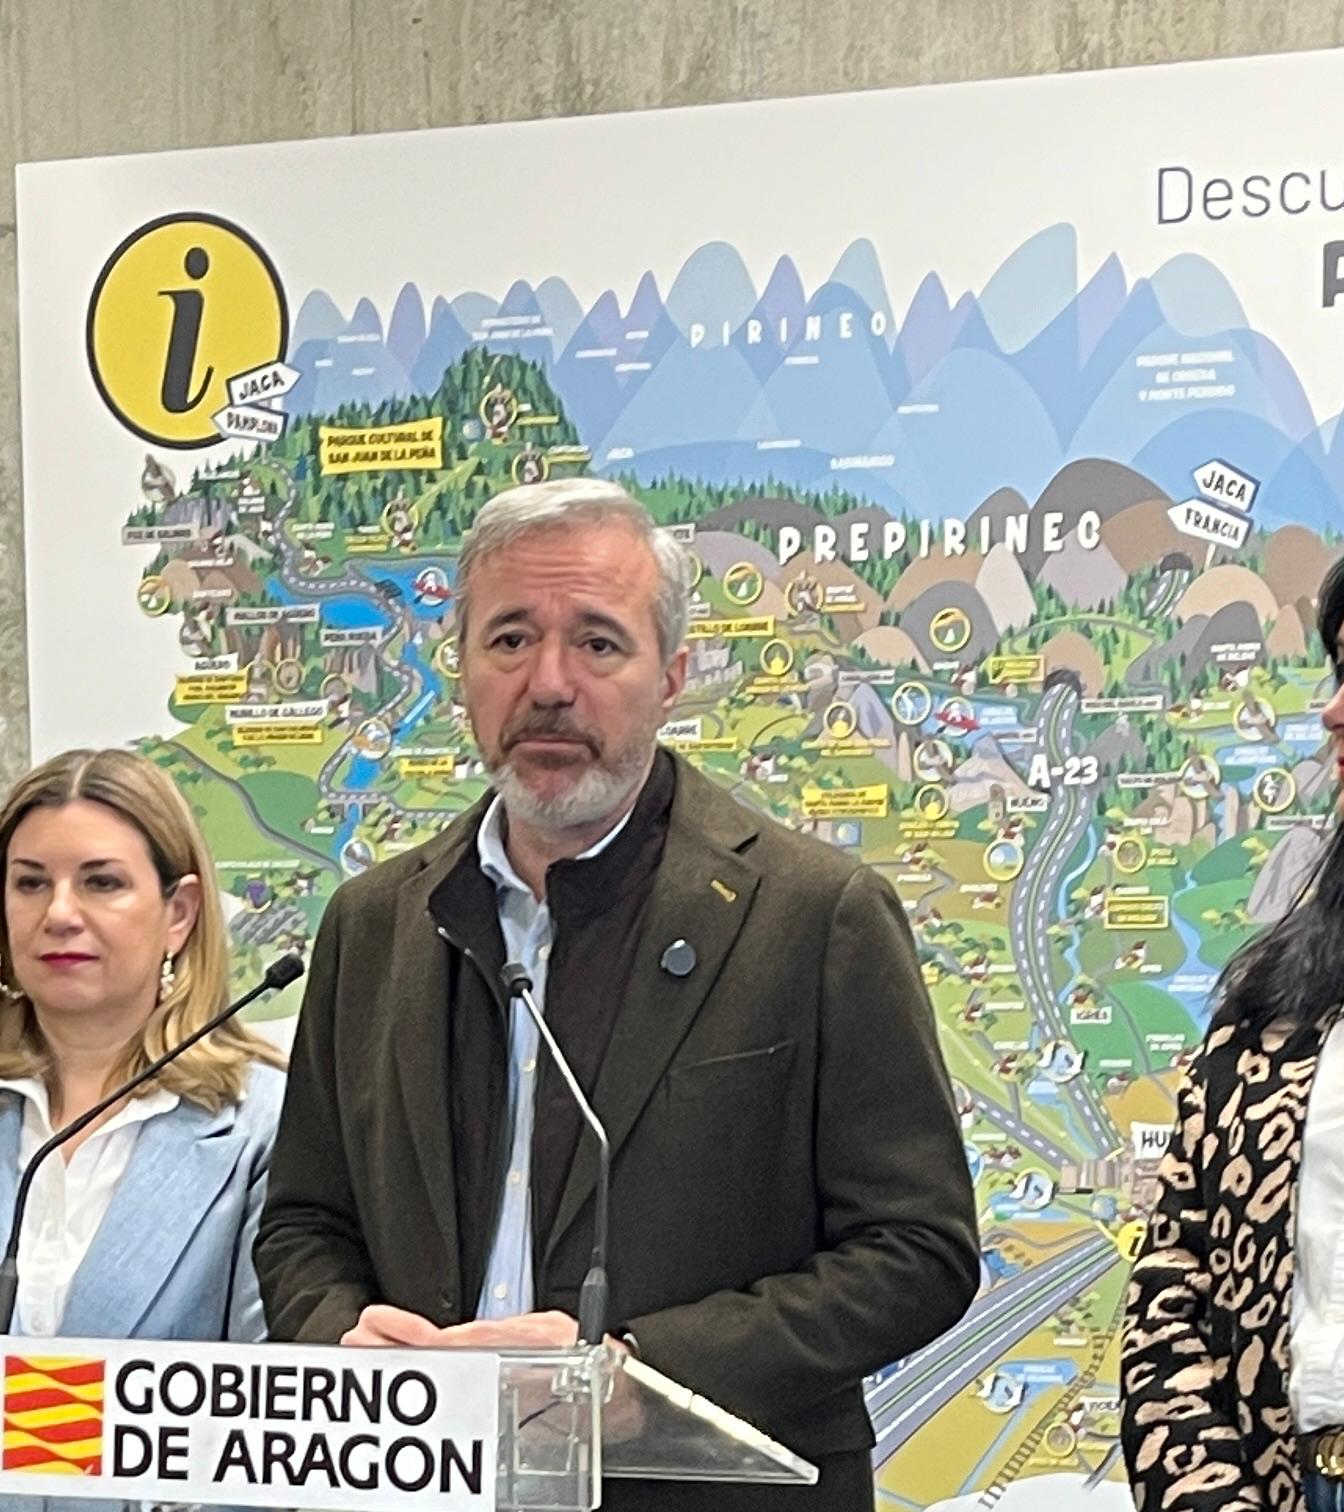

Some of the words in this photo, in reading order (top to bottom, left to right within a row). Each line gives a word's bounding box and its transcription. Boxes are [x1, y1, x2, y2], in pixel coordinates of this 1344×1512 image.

[689, 311, 887, 349] PIRINEO
[239, 371, 285, 400] JACA
[1202, 470, 1247, 503] JACA
[778, 509, 1102, 566] PREPIRINEO
[1185, 507, 1240, 541] FRANCIA
[1028, 755, 1099, 790] A-23
[114, 1360, 439, 1427] GOBIERNO
[112, 1425, 190, 1480] DE
[212, 1430, 483, 1495] ARAGON
